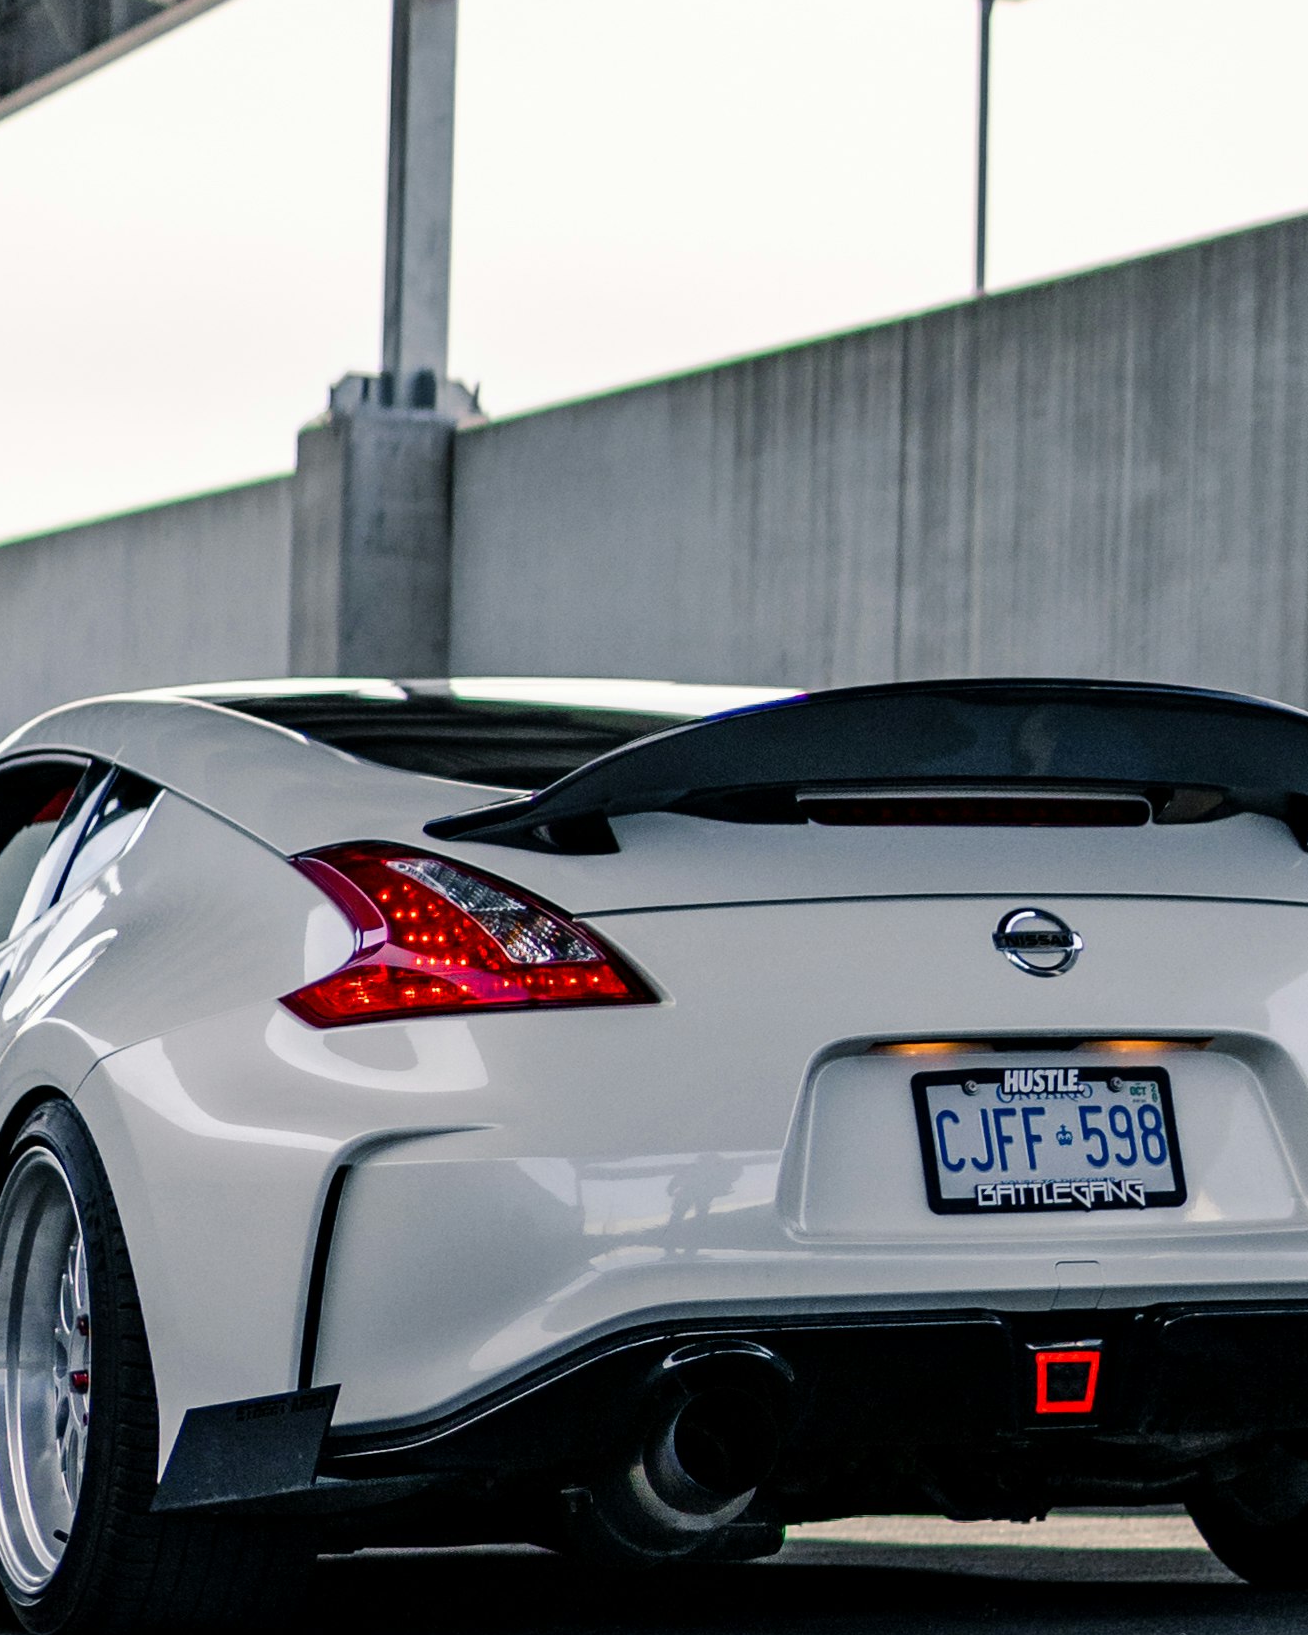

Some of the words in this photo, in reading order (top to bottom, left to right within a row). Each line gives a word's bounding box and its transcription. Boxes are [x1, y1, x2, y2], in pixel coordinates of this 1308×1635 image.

[1004, 933, 1072, 946] NISSAN
[1004, 1069, 1085, 1093] HUSTLE.
[935, 1106, 1046, 1173] CJFF
[1078, 1103, 1167, 1168] 598
[977, 1179, 1146, 1209] BATTLEGANG
